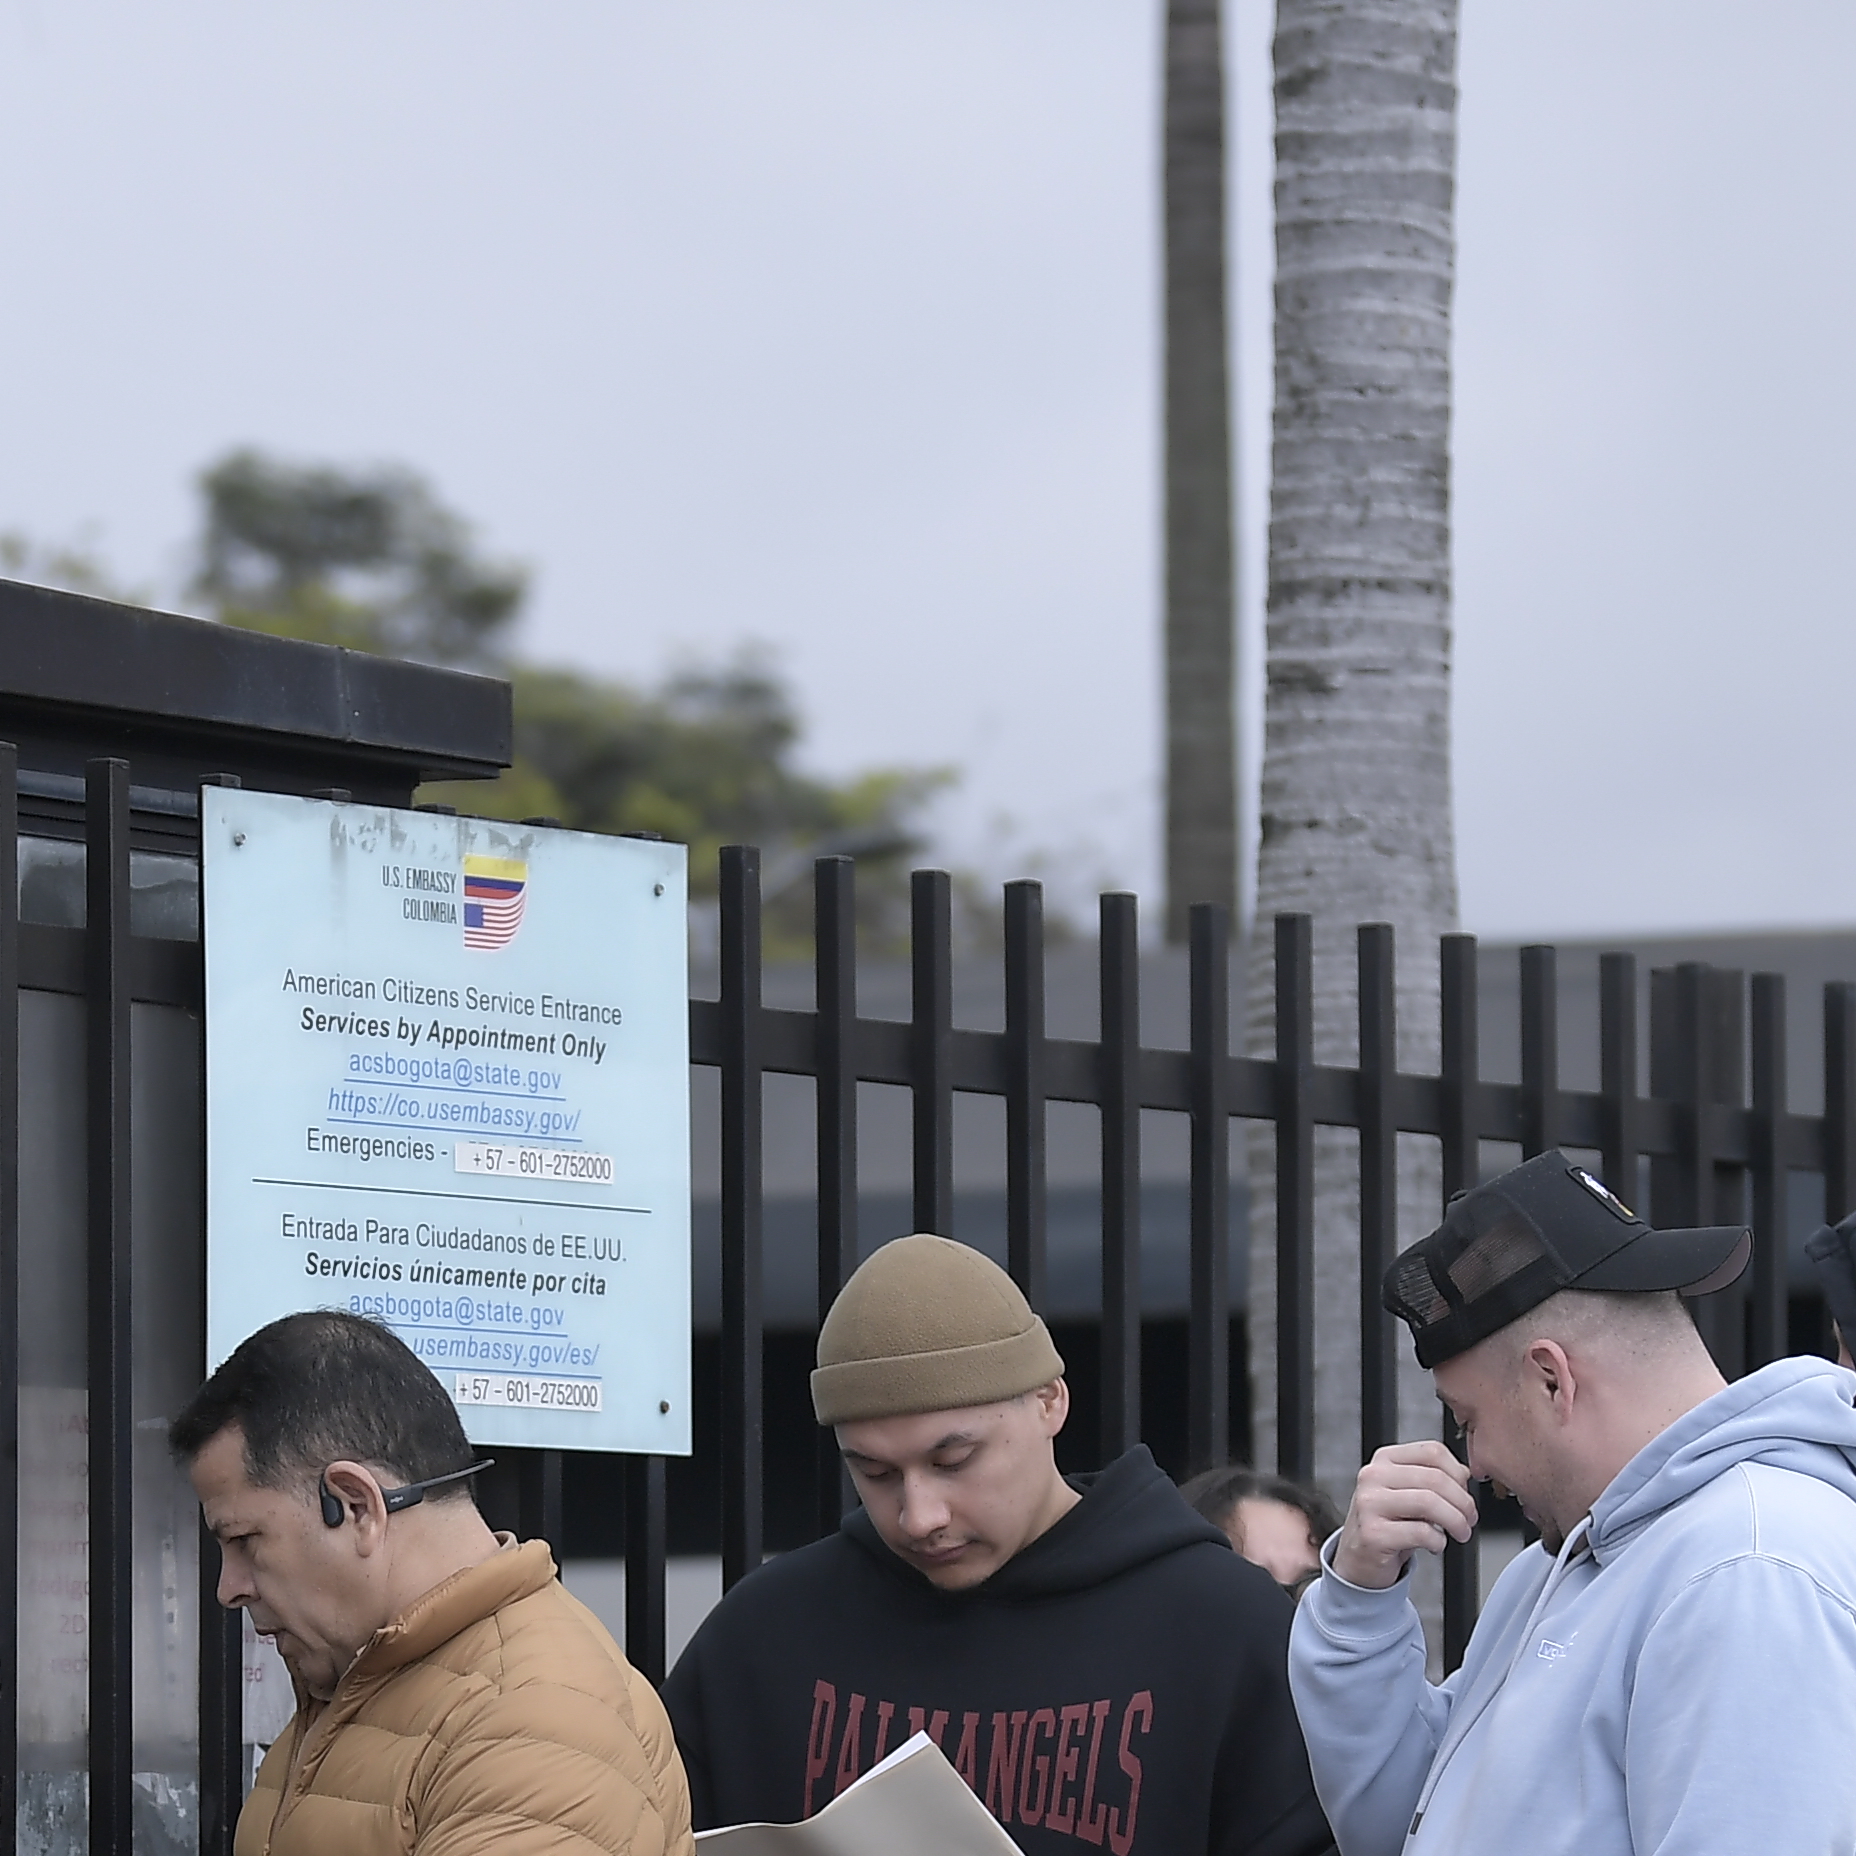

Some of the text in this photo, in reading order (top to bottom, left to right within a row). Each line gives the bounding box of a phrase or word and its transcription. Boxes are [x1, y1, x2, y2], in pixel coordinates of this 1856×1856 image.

[383, 865, 457, 894] U.S. EMBASSY
[403, 898, 457, 925] COLOMBIA
[282, 969, 623, 1025] American Citizens Service Entrance
[300, 1007, 607, 1064] Services by Appointment Only
[349, 1052, 562, 1090] acsbogota@state.gov
[328, 1089, 582, 1132] https://co.usembassy.gov/
[307, 1127, 434, 1162] Emergencies
[282, 1213, 627, 1262] Entrada Para Ciudadanos de EE.UU.
[305, 1252, 607, 1297] Servicios únicamente por cita
[349, 1291, 565, 1328] acsbogota@state.gov
[413, 1334, 601, 1368] usembassy.gov/es/
